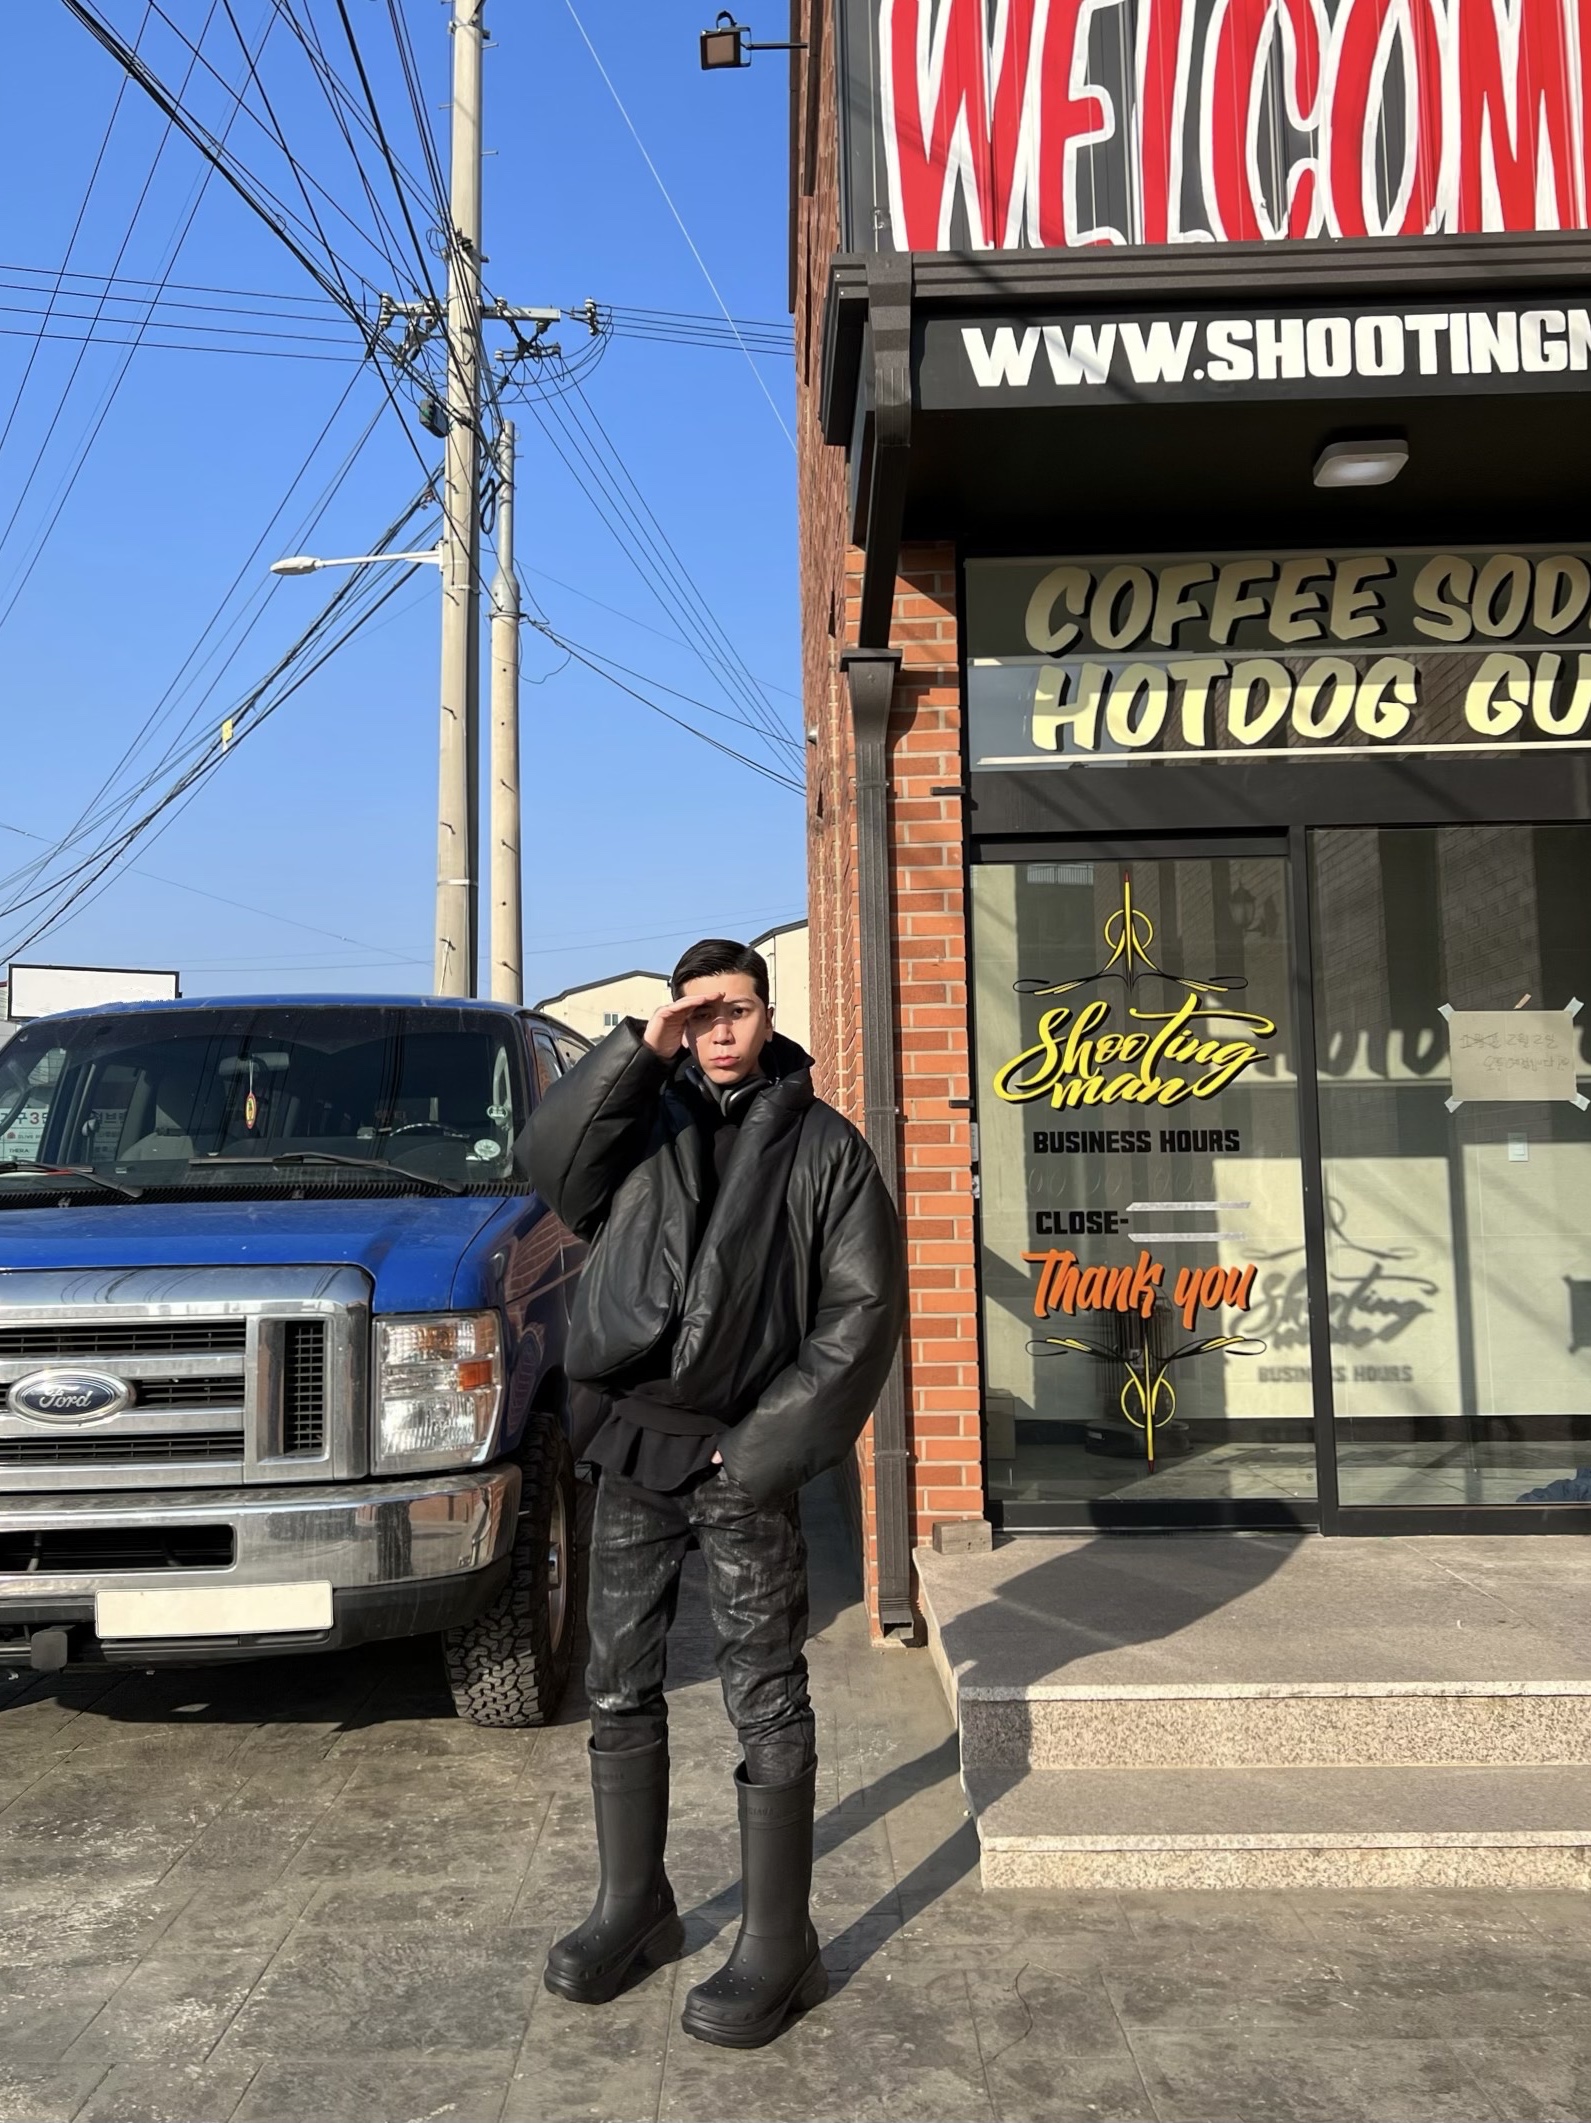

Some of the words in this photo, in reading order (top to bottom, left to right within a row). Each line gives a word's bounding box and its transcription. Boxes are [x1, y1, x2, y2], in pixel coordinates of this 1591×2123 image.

[879, 0, 1591, 252] WELCOM
[1025, 556, 1397, 656] COFFEE
[1413, 554, 1591, 643] SOD
[1031, 656, 1418, 751] HOTDOG
[993, 992, 1277, 1104] Shooting
[1050, 1072, 1195, 1113] man
[1033, 1131, 1152, 1153] BUSINESS
[1159, 1129, 1240, 1152] HOURS
[1036, 1211, 1129, 1234] CLOSE-
[1020, 1248, 1164, 1319] Thank
[1173, 1263, 1258, 1331] you
[38, 1382, 94, 1409] Ford
